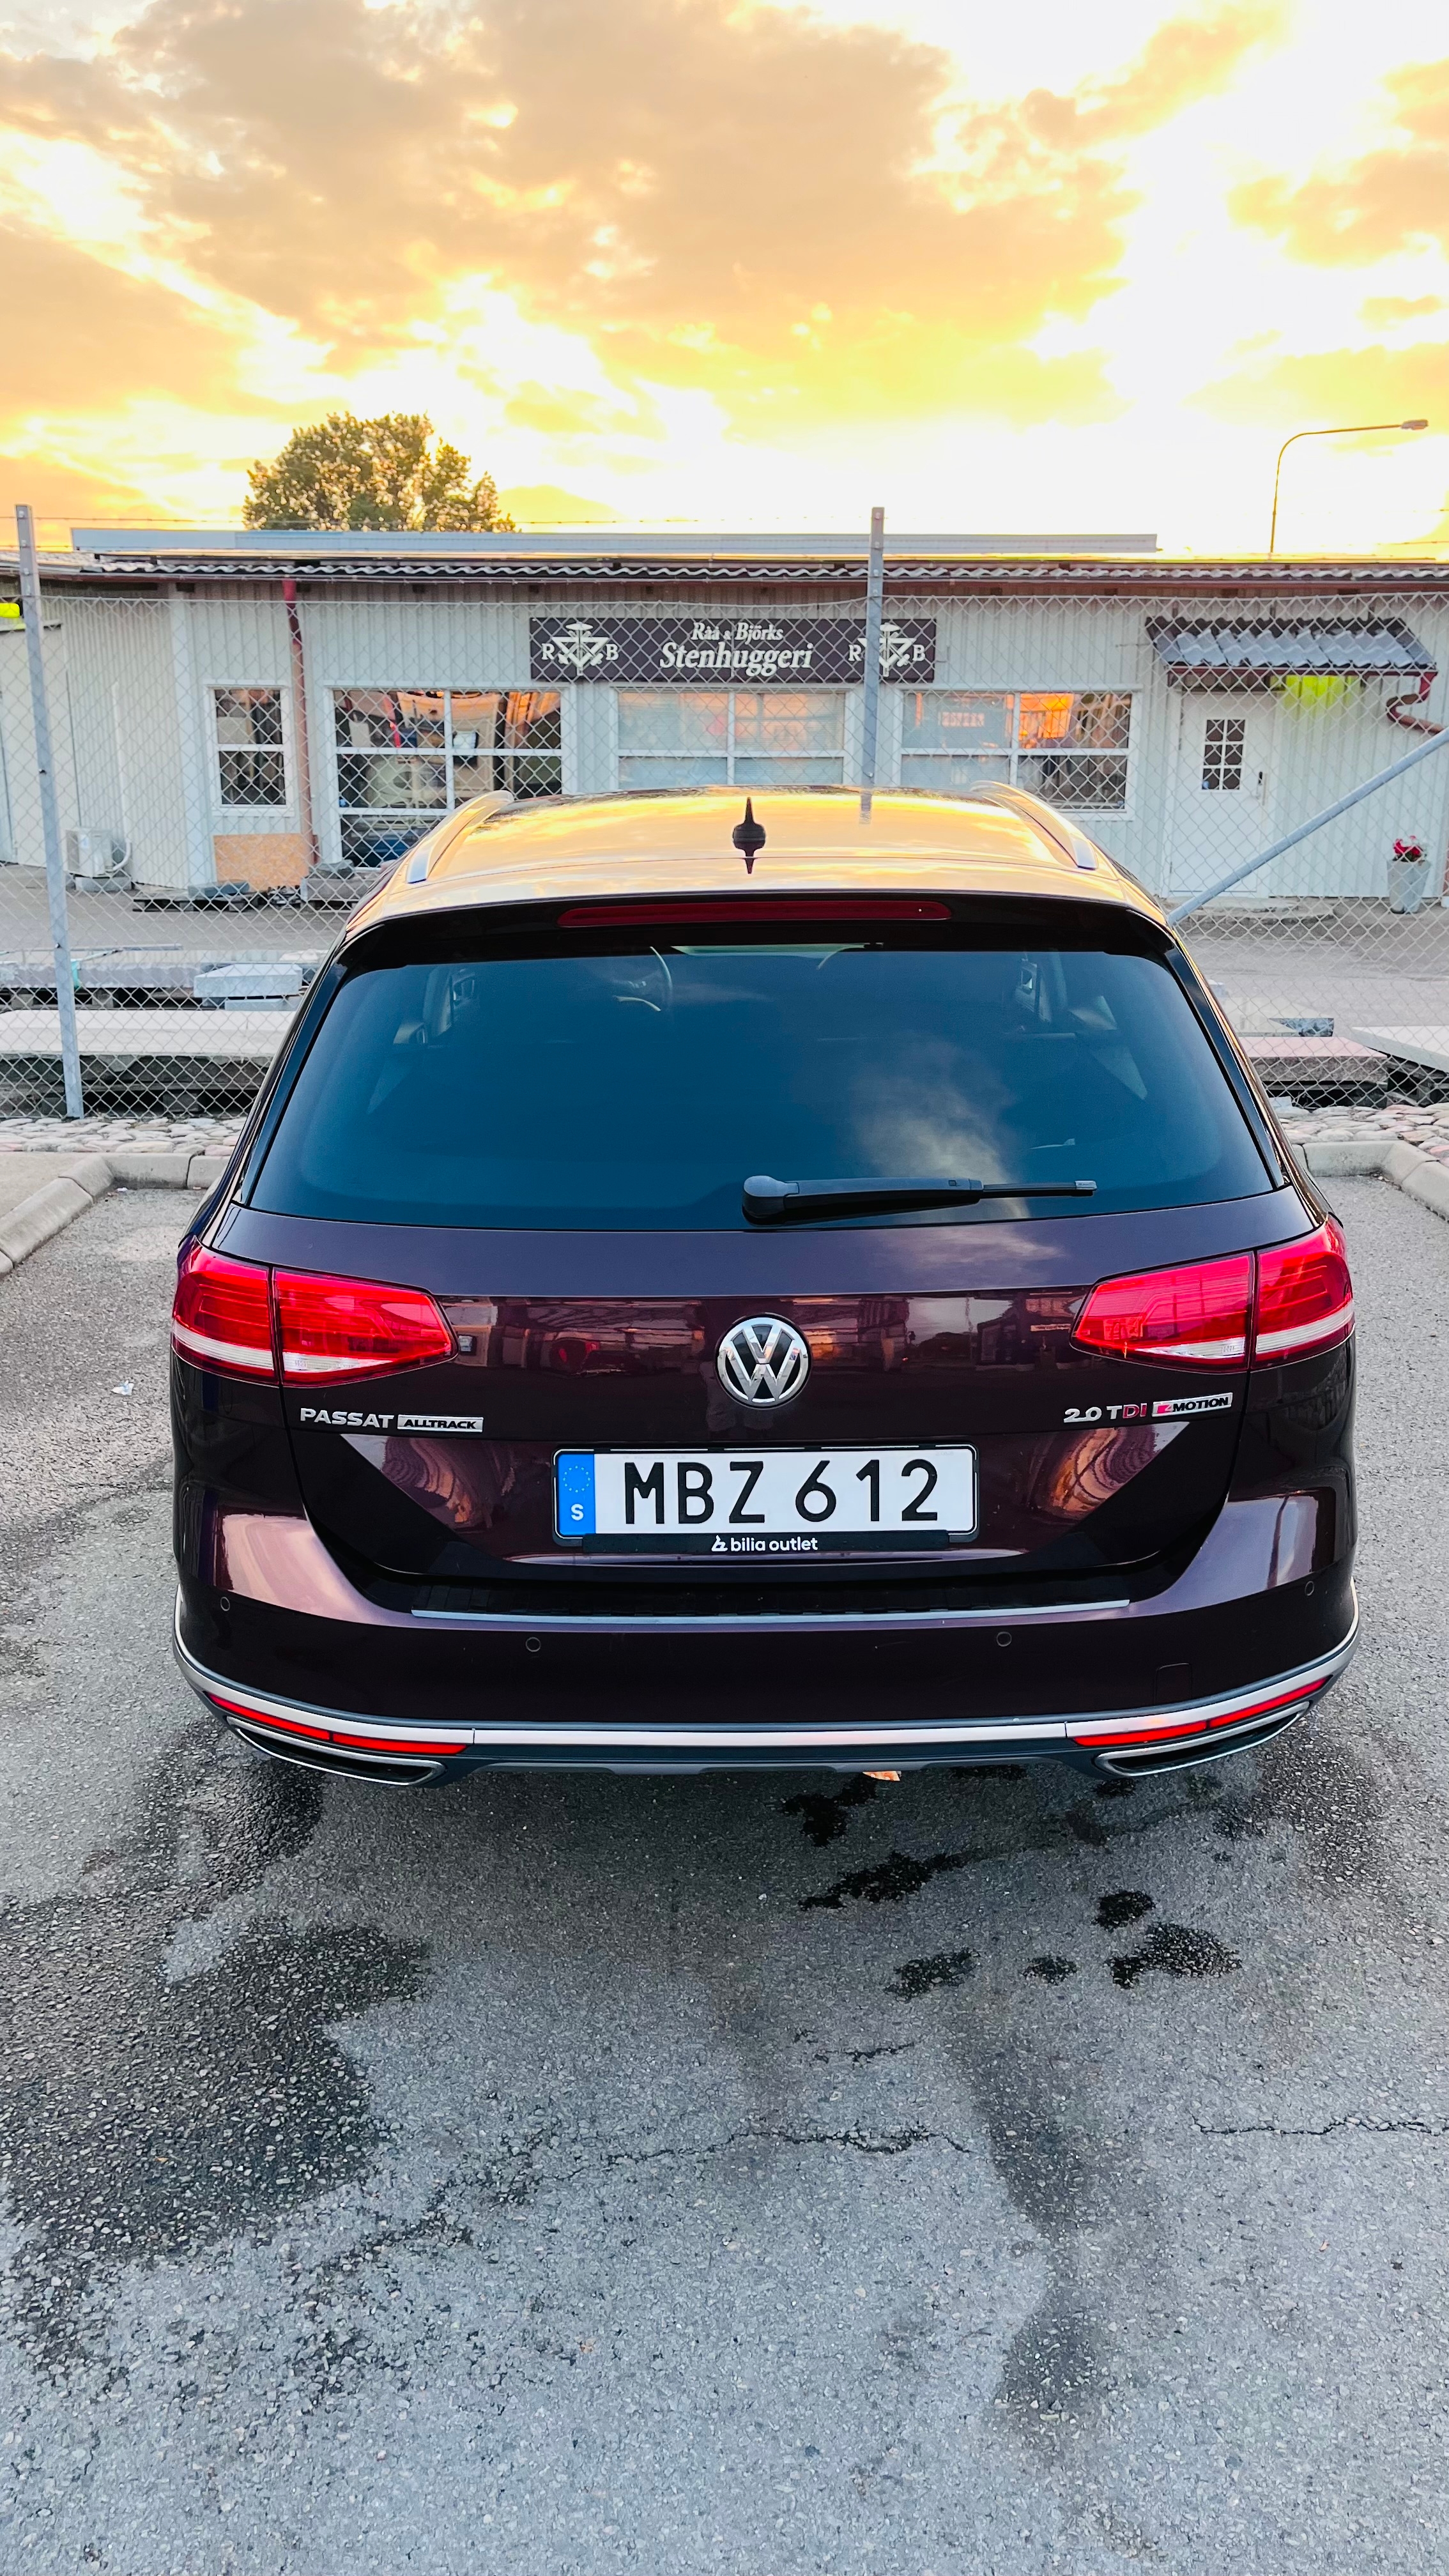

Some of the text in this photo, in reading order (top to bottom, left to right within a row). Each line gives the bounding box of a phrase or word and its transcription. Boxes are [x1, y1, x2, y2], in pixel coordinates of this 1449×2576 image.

[691, 622, 784, 645] Råå & Björks
[541, 643, 619, 661] R B
[659, 641, 814, 677] Stenhuggeri
[848, 644, 926, 661] R B
[300, 1407, 477, 1429] PASSAT ALLTRACK
[1106, 1403, 1147, 1420] TDI
[624, 1459, 938, 1524] MBZ 612
[571, 1503, 584, 1521] S
[730, 1536, 818, 1552] bilia outlet
